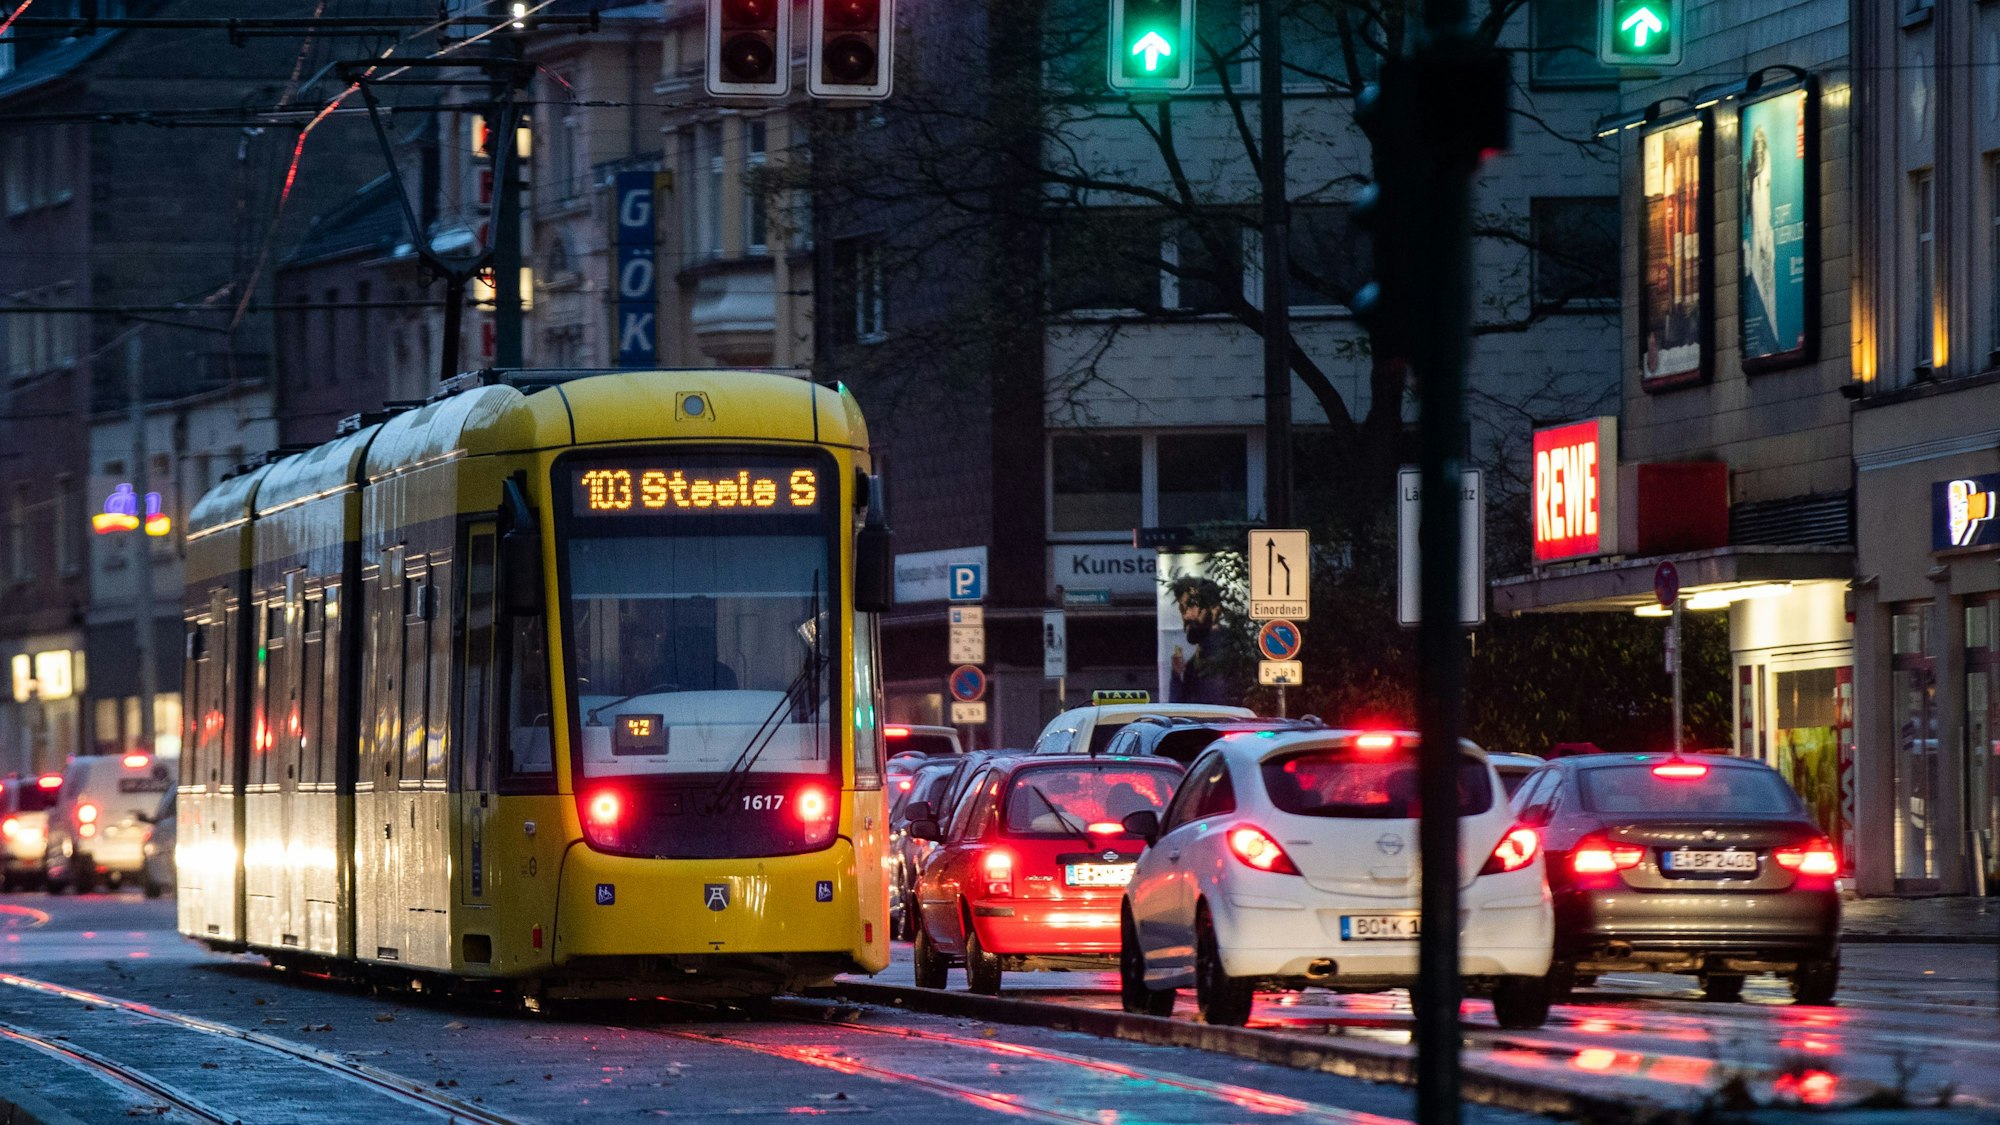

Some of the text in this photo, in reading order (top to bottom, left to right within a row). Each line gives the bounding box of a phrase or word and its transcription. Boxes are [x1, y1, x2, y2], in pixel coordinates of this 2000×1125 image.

[620, 188, 654, 351] GÖK
[582, 470, 816, 510] 103 Steele S
[1536, 441, 1597, 542] REWE
[955, 567, 976, 597] P
[1254, 603, 1304, 616] Einordnen
[1104, 690, 1141, 699] TAXI
[629, 719, 650, 736] 42
[742, 795, 784, 811] 1617
[1357, 919, 1380, 935] BO
